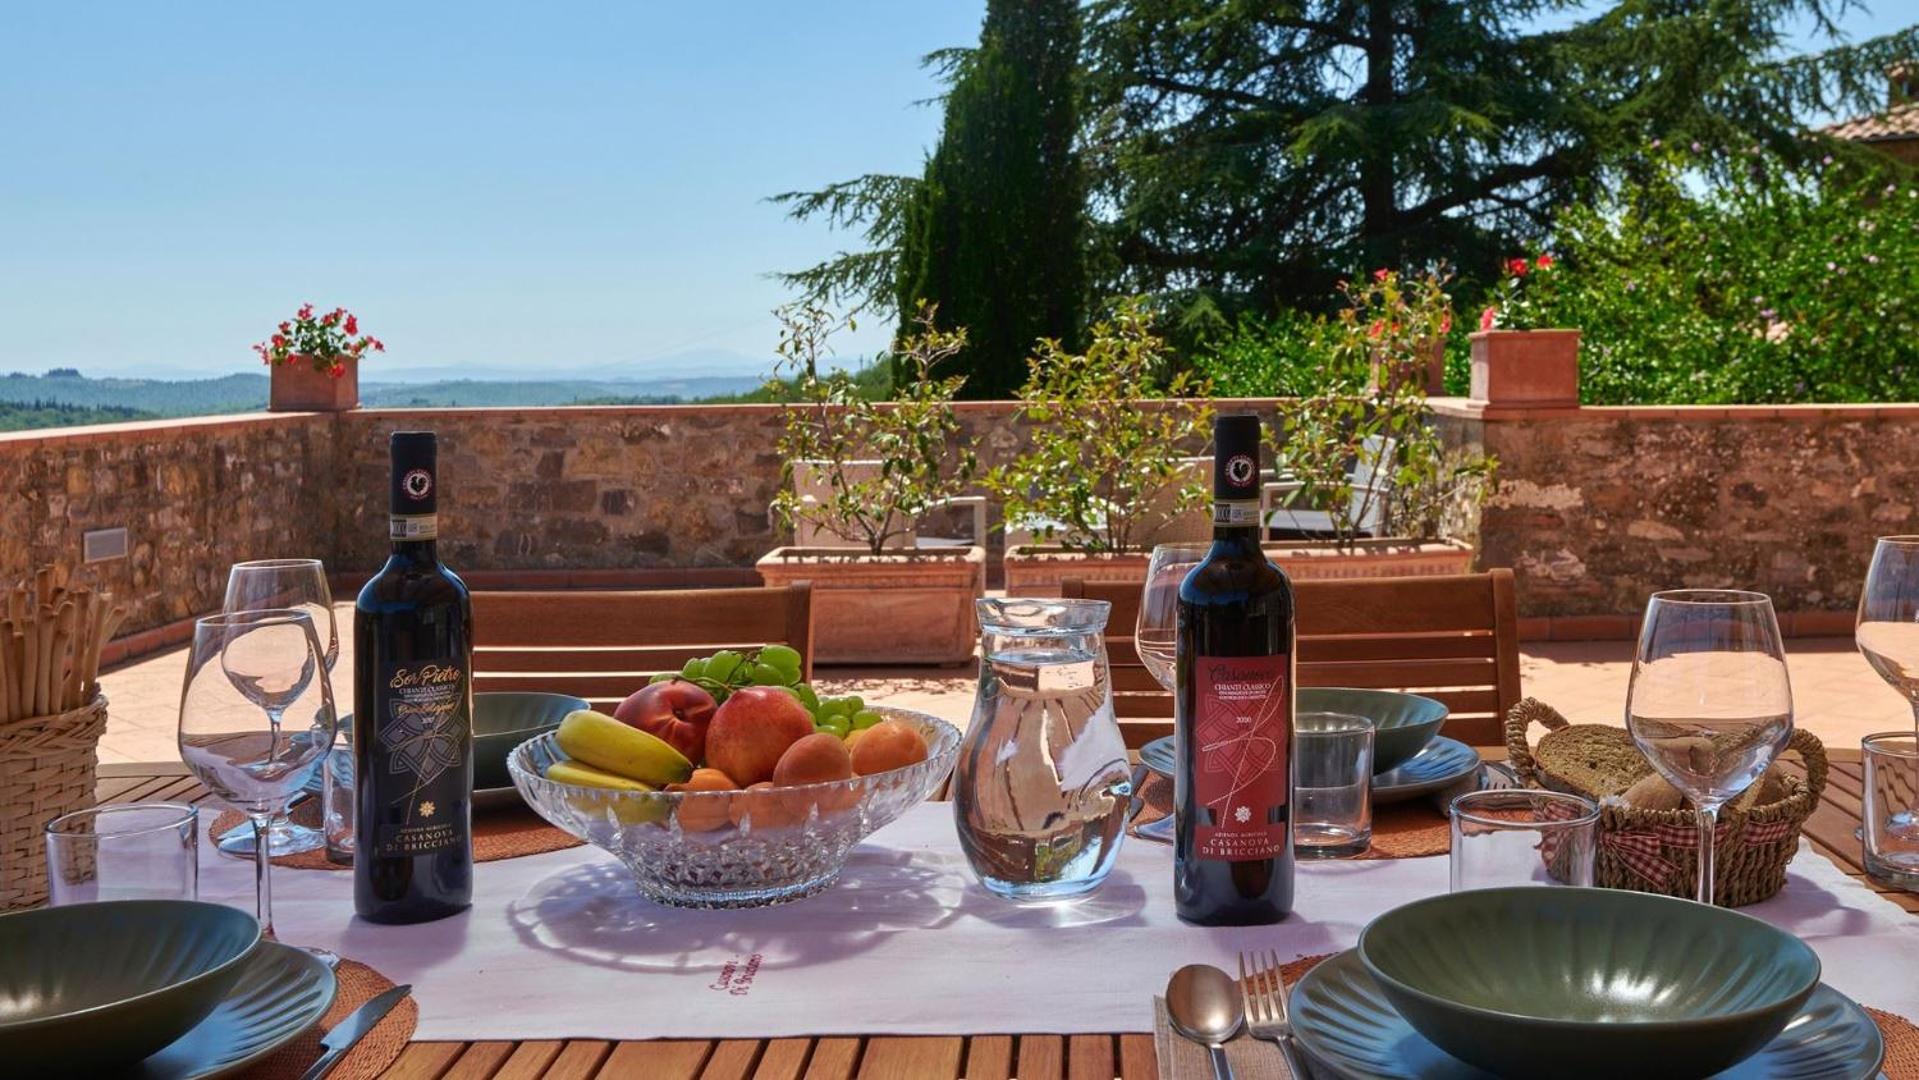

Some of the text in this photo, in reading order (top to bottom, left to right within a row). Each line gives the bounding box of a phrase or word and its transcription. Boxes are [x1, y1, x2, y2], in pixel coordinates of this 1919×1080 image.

[420, 664, 461, 686] Pietro
[1242, 683, 1271, 691] CLASSICO
[396, 829, 454, 843] CASANOVA
[1210, 837, 1269, 847] CASANOVA
[1202, 844, 1280, 856] DI BRICCIANO
